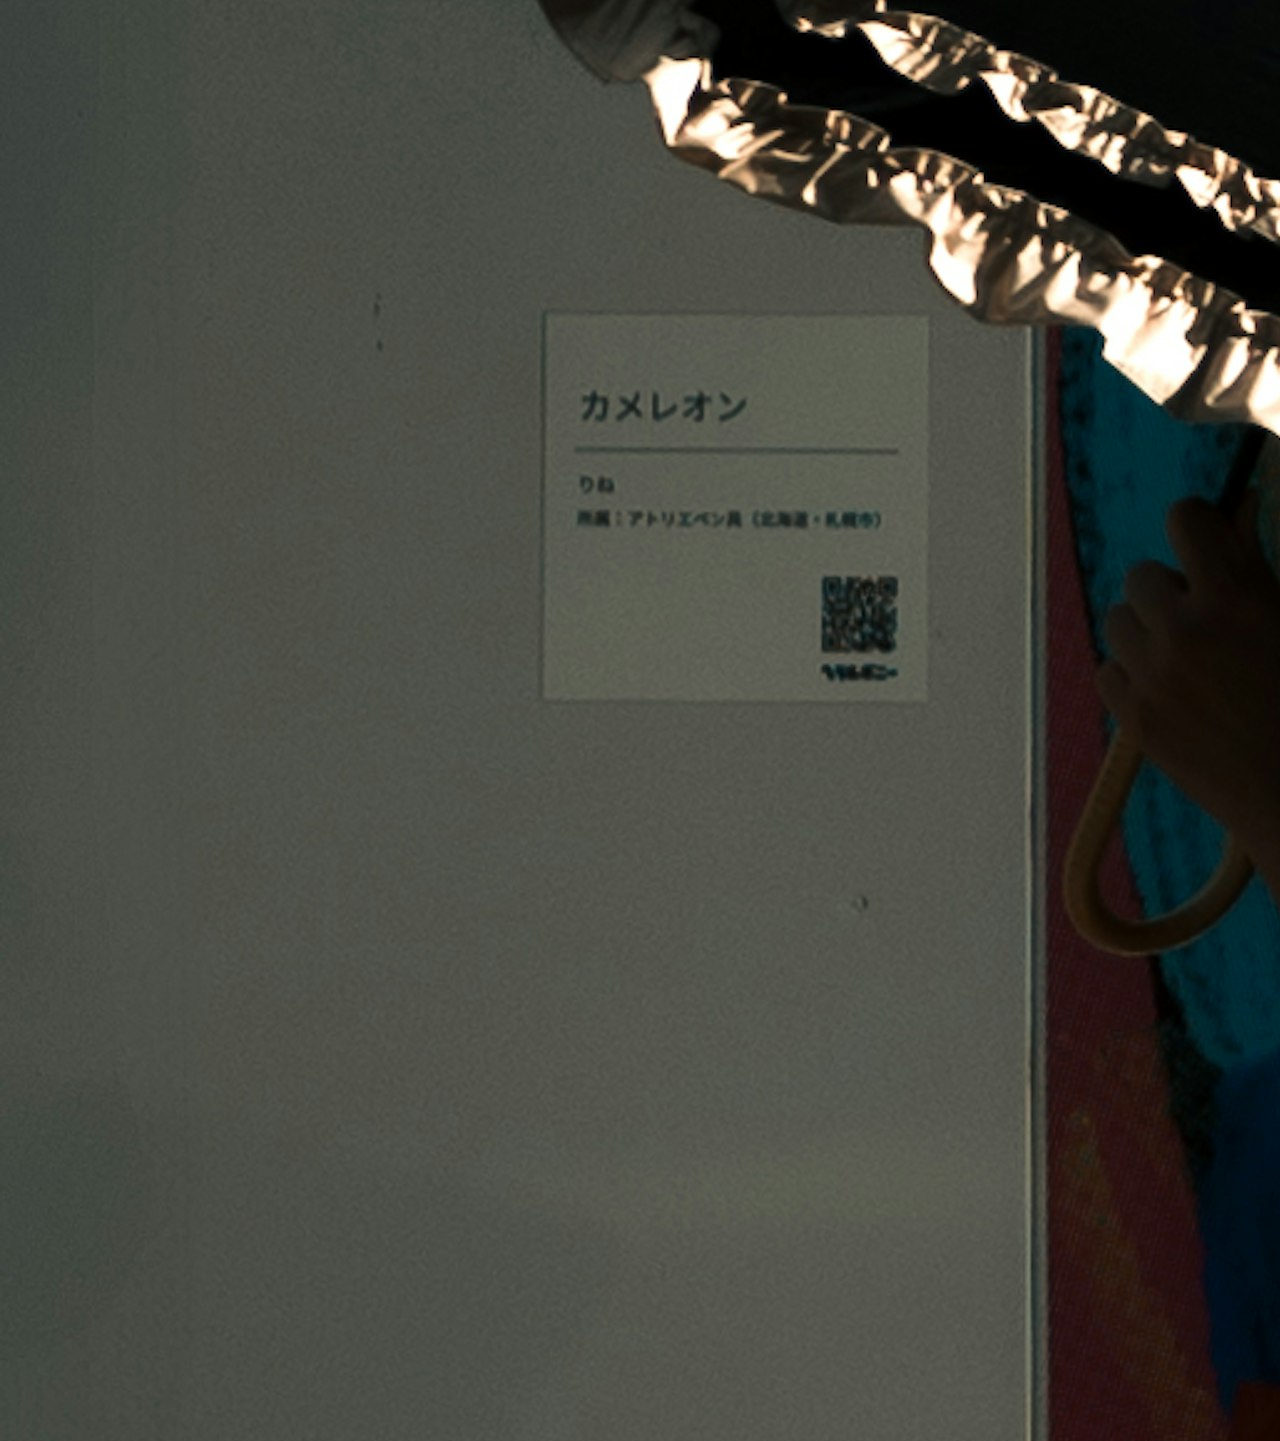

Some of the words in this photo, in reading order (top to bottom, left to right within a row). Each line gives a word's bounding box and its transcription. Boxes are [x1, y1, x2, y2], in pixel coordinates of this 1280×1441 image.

[581, 390, 746, 423] カメレオン
